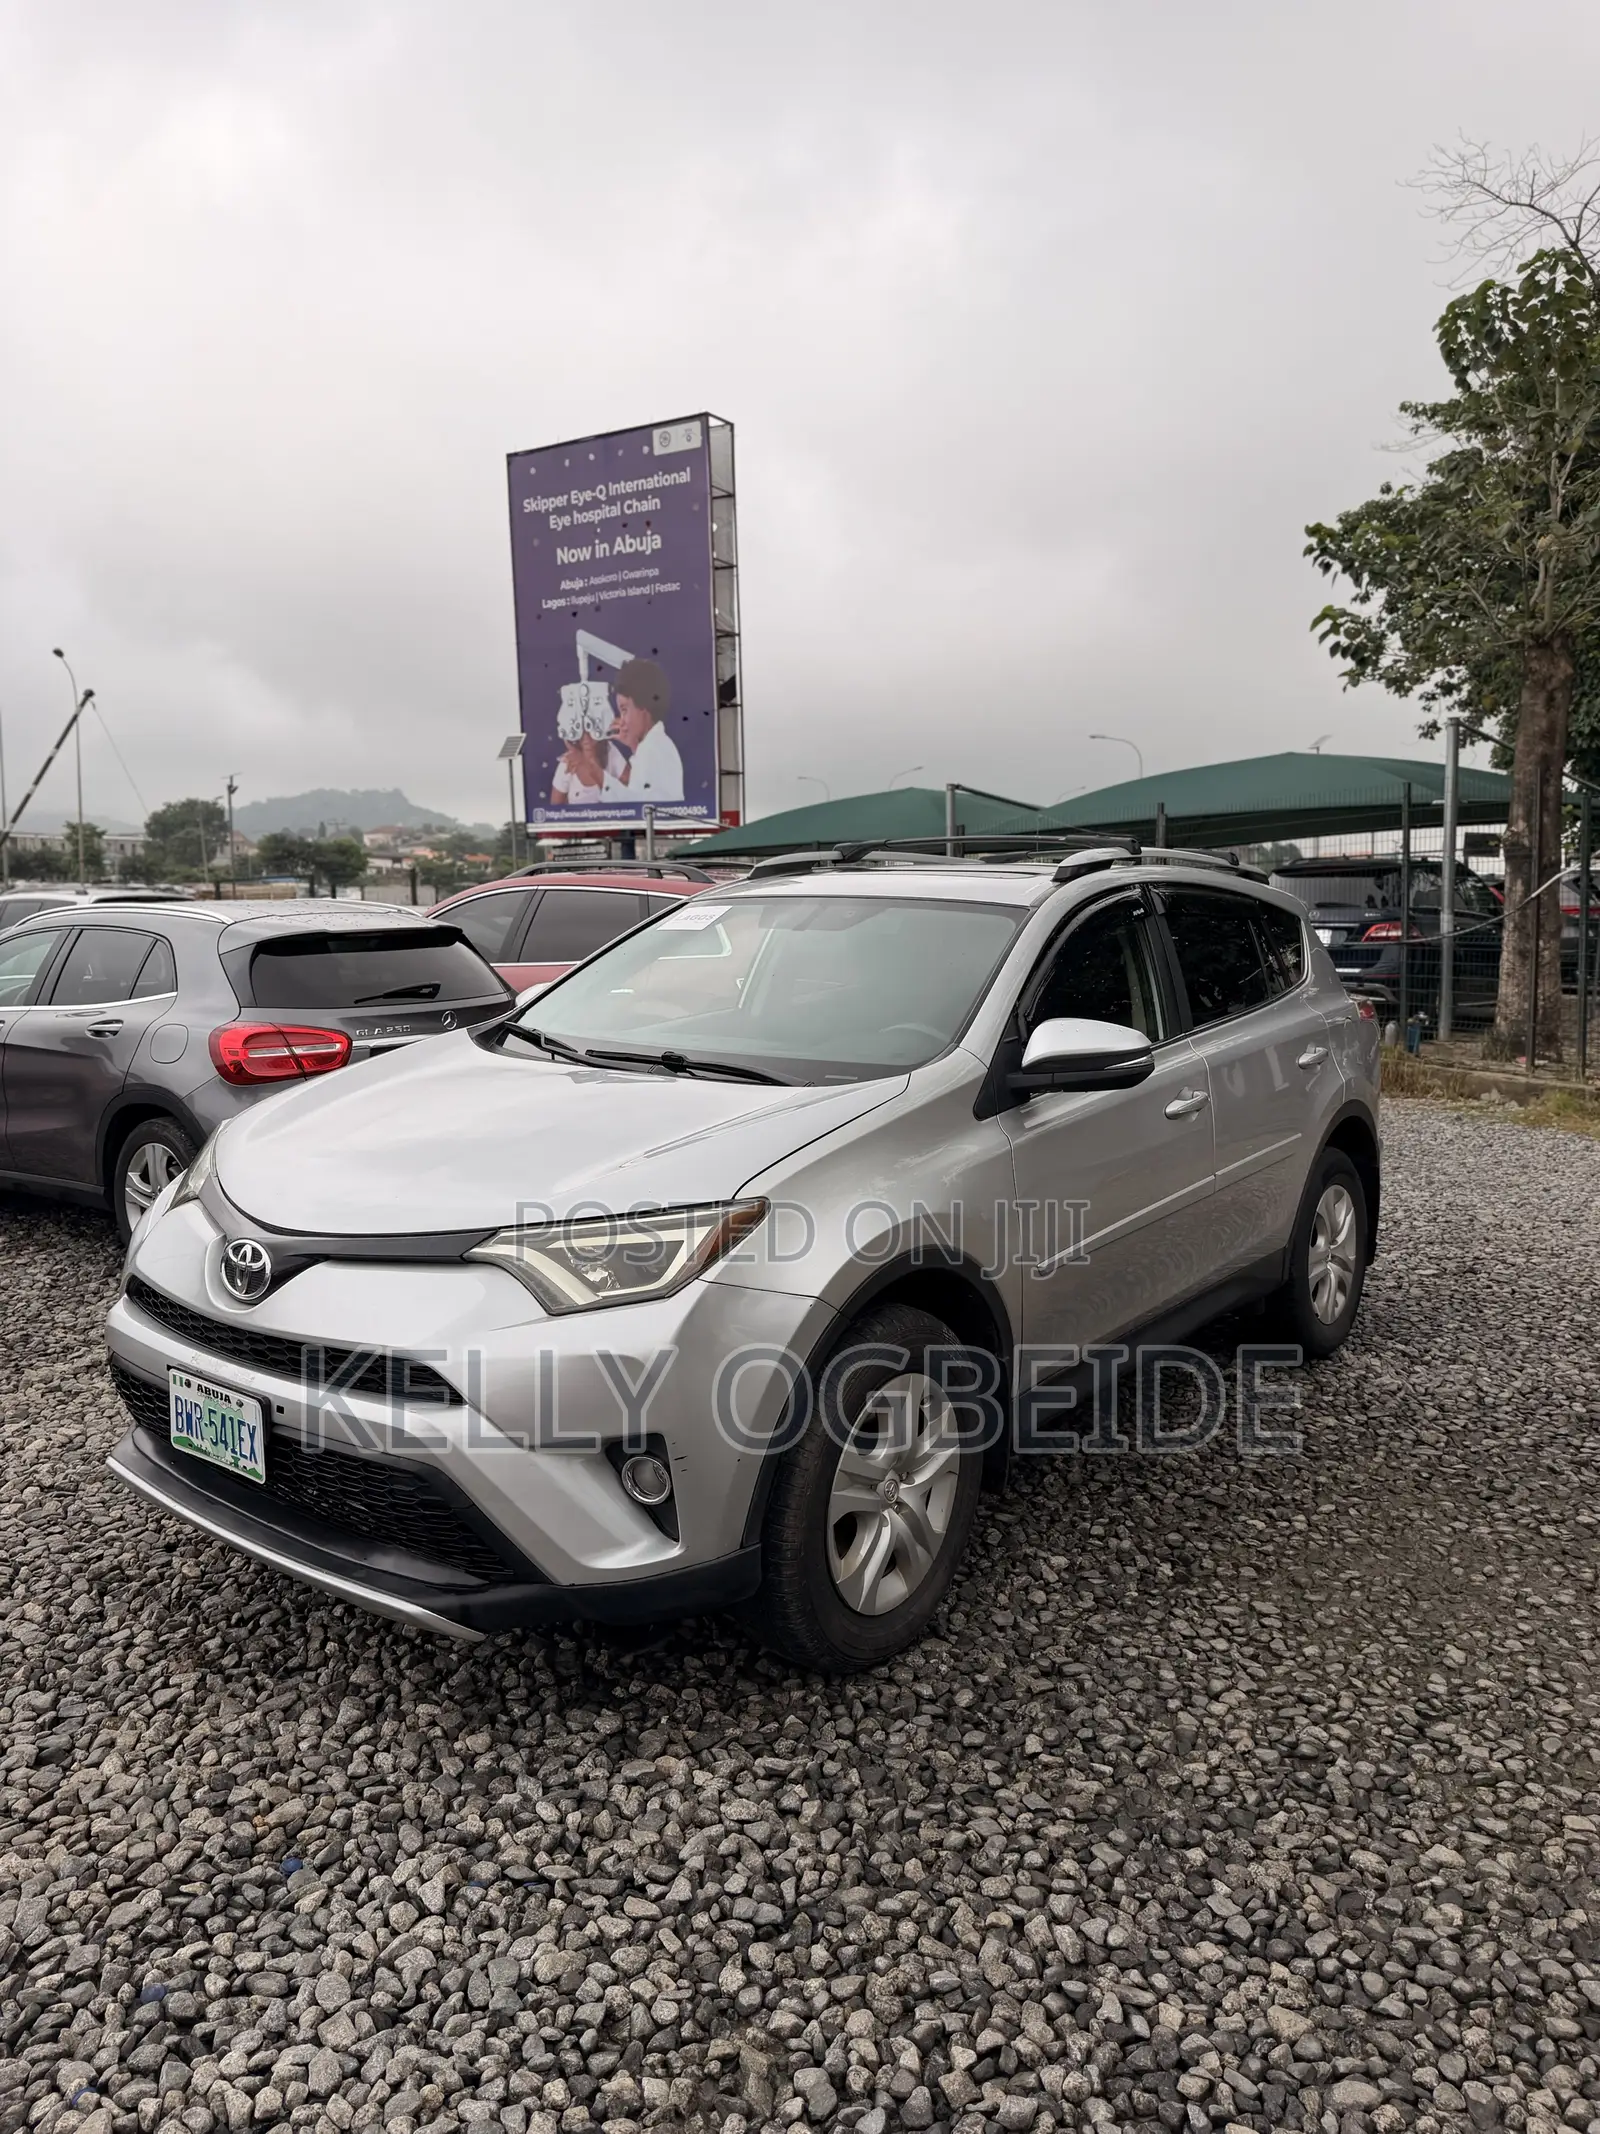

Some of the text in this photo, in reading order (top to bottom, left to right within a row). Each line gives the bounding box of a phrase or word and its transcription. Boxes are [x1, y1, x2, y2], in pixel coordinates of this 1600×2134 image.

[523, 467, 691, 513] Skipper Eye-Q International
[550, 495, 661, 531] Eye hospital Chain
[556, 530, 662, 565] Now in Abuja
[599, 588, 626, 600] Victoria
[627, 584, 650, 597] Island
[655, 582, 681, 593] Festac
[196, 1383, 232, 1405] ABUJA
